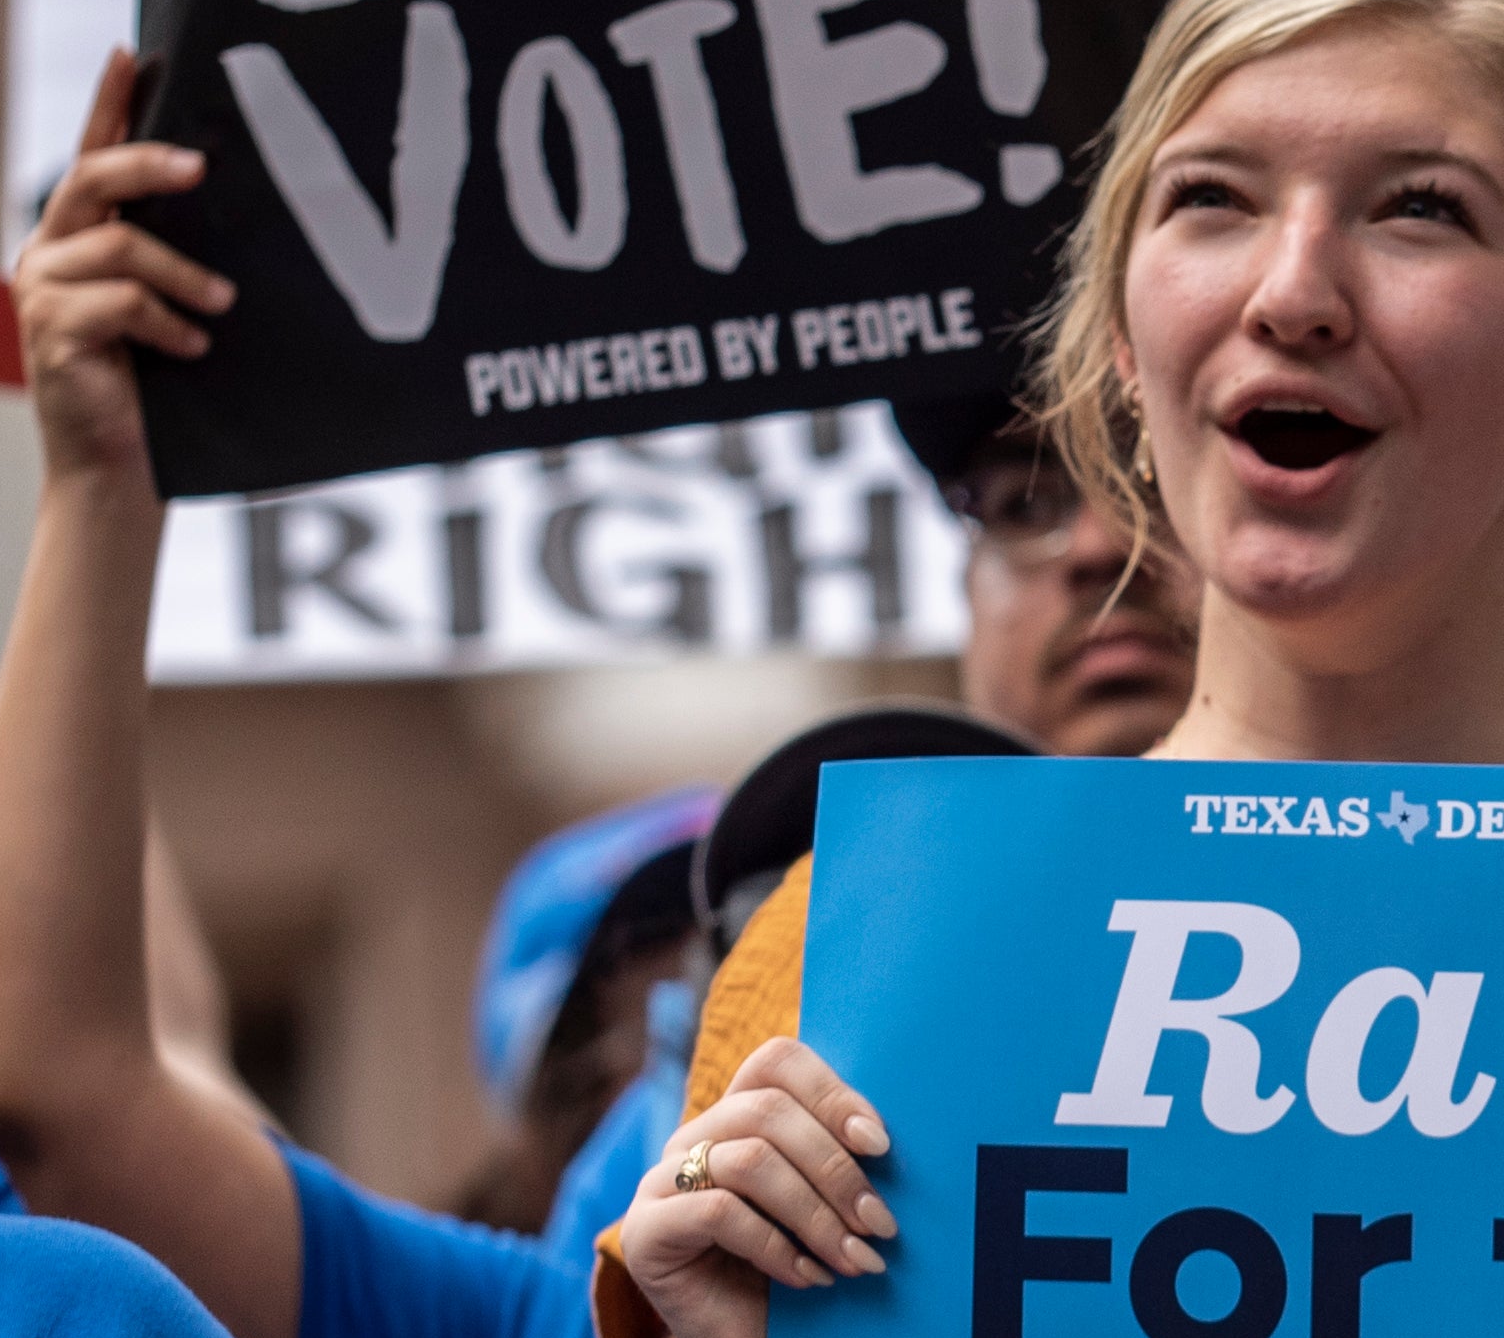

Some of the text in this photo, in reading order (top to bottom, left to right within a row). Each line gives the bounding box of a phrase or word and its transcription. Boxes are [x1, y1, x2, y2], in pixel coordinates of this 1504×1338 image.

[465, 286, 983, 415] POWERED BY PEOPLE
[234, 479, 904, 643] RIGH
[1185, 795, 1370, 837] TEXAS
